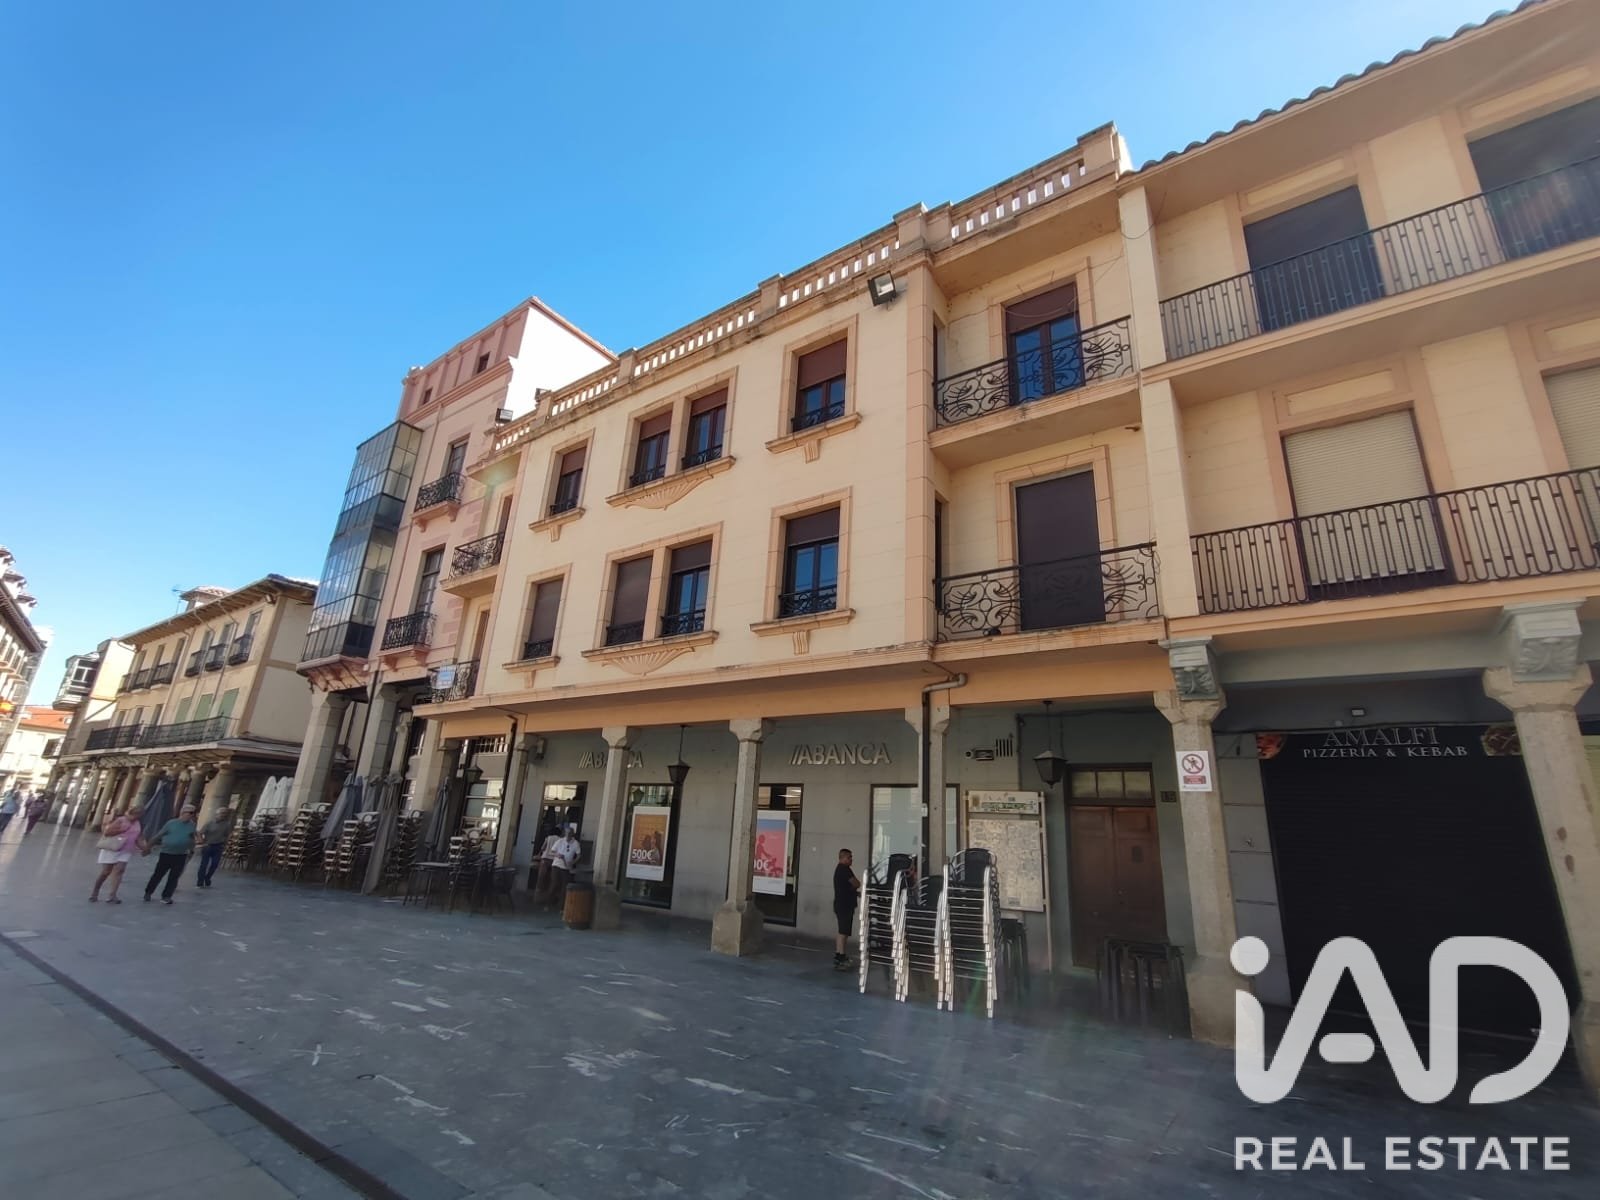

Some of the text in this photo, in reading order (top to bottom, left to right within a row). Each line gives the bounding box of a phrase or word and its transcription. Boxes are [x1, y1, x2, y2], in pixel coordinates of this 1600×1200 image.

[1323, 727, 1440, 746] AMALFI
[1386, 748, 1397, 757] &
[1408, 746, 1468, 757] KEBAB
[632, 848, 652, 860] 500€
